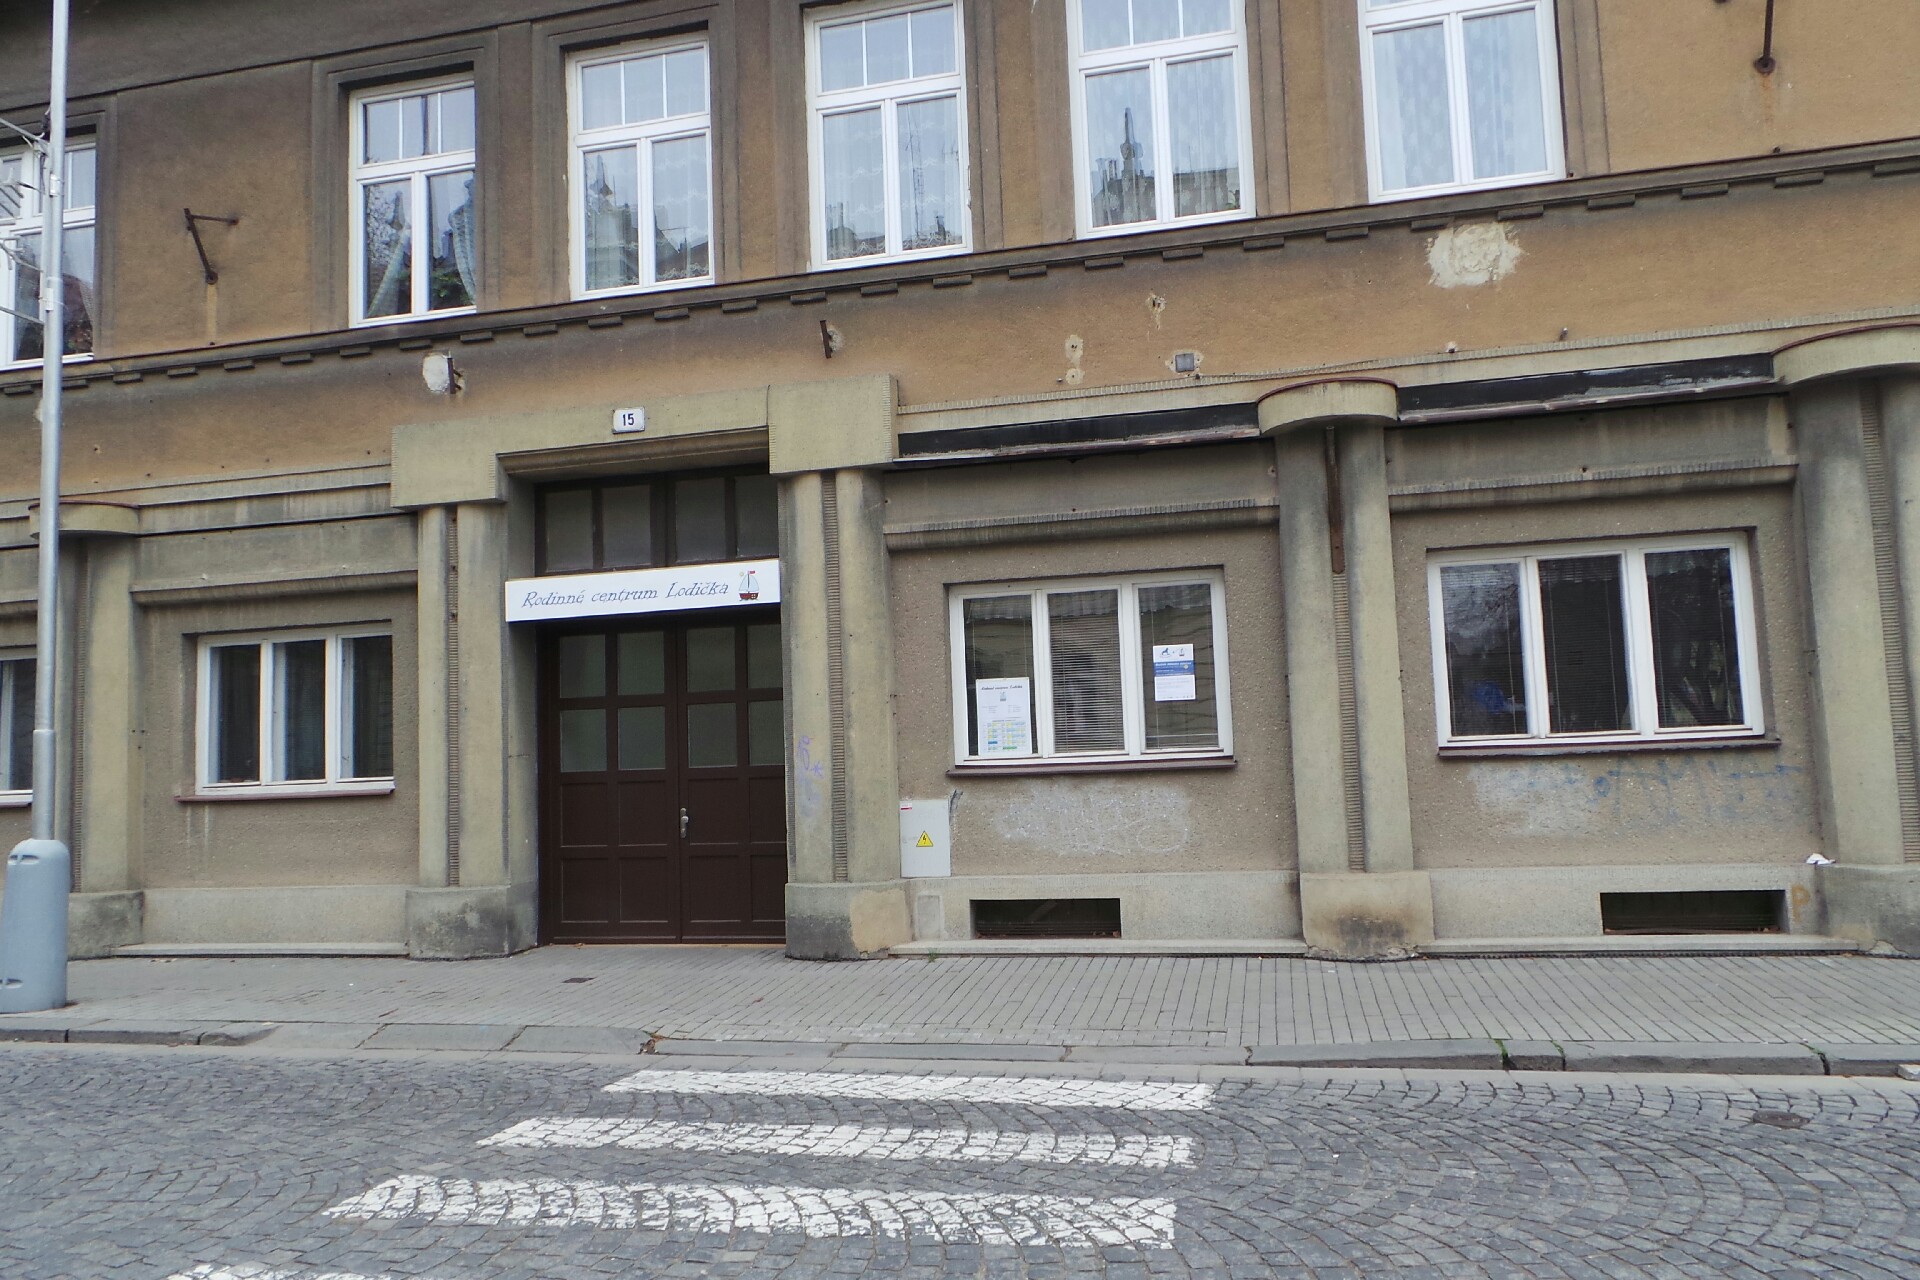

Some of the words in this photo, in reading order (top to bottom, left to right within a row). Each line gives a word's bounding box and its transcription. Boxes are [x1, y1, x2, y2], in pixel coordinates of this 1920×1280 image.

[622, 413, 635, 426] 15
[522, 590, 586, 608] Rodinné
[591, 588, 658, 603] centrum
[665, 581, 729, 599] Lodička
